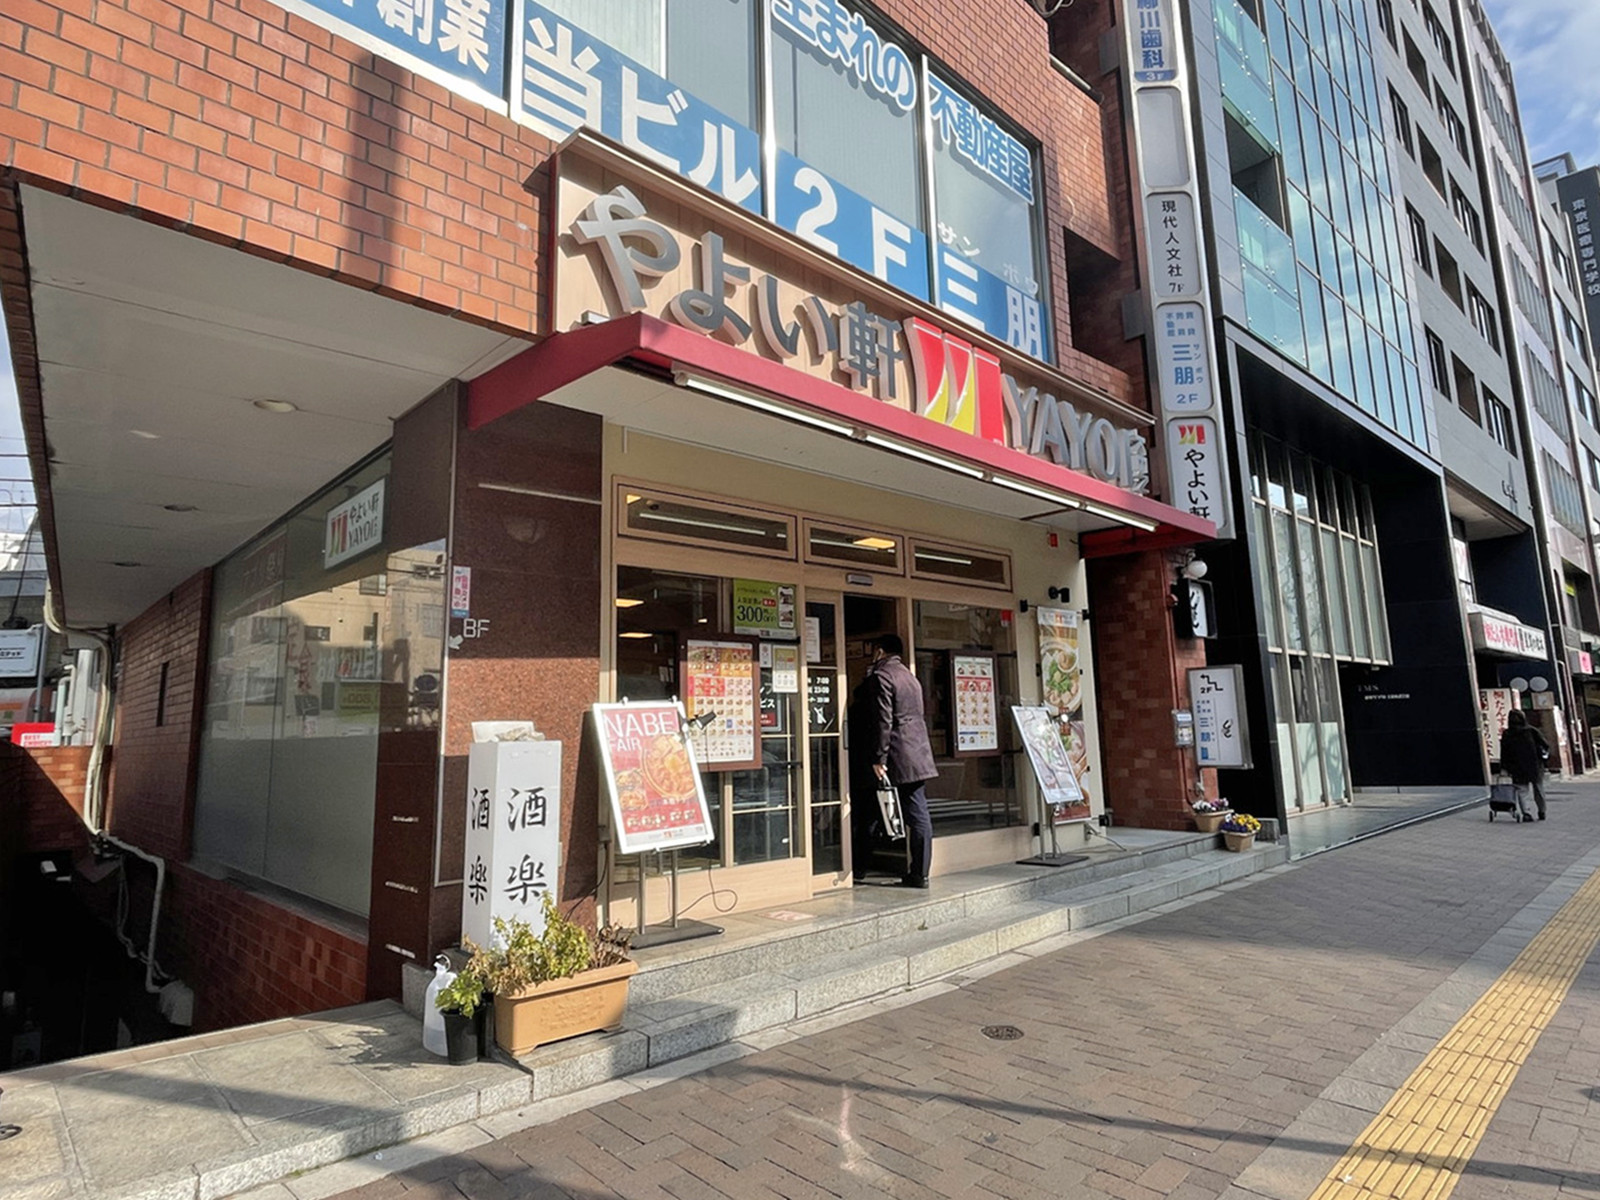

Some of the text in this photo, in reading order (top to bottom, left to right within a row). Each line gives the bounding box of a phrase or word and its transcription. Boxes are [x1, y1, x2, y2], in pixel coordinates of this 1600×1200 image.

[524, 17, 759, 202] 当ビル
[928, 71, 1034, 205] 不動産屋
[937, 221, 981, 257] サン
[1161, 200, 1183, 278] 現代人文社
[567, 183, 904, 400] やよい軒
[1169, 282, 1185, 293] 7F
[1172, 343, 1194, 385] 三朋
[1176, 393, 1199, 405] 2F
[463, 618, 490, 638] BF
[736, 605, 764, 623] 300
[602, 711, 677, 738] NABE
[607, 736, 642, 753] FAIR
[468, 786, 490, 906] 酒楽
[503, 786, 548, 906] 酒楽
